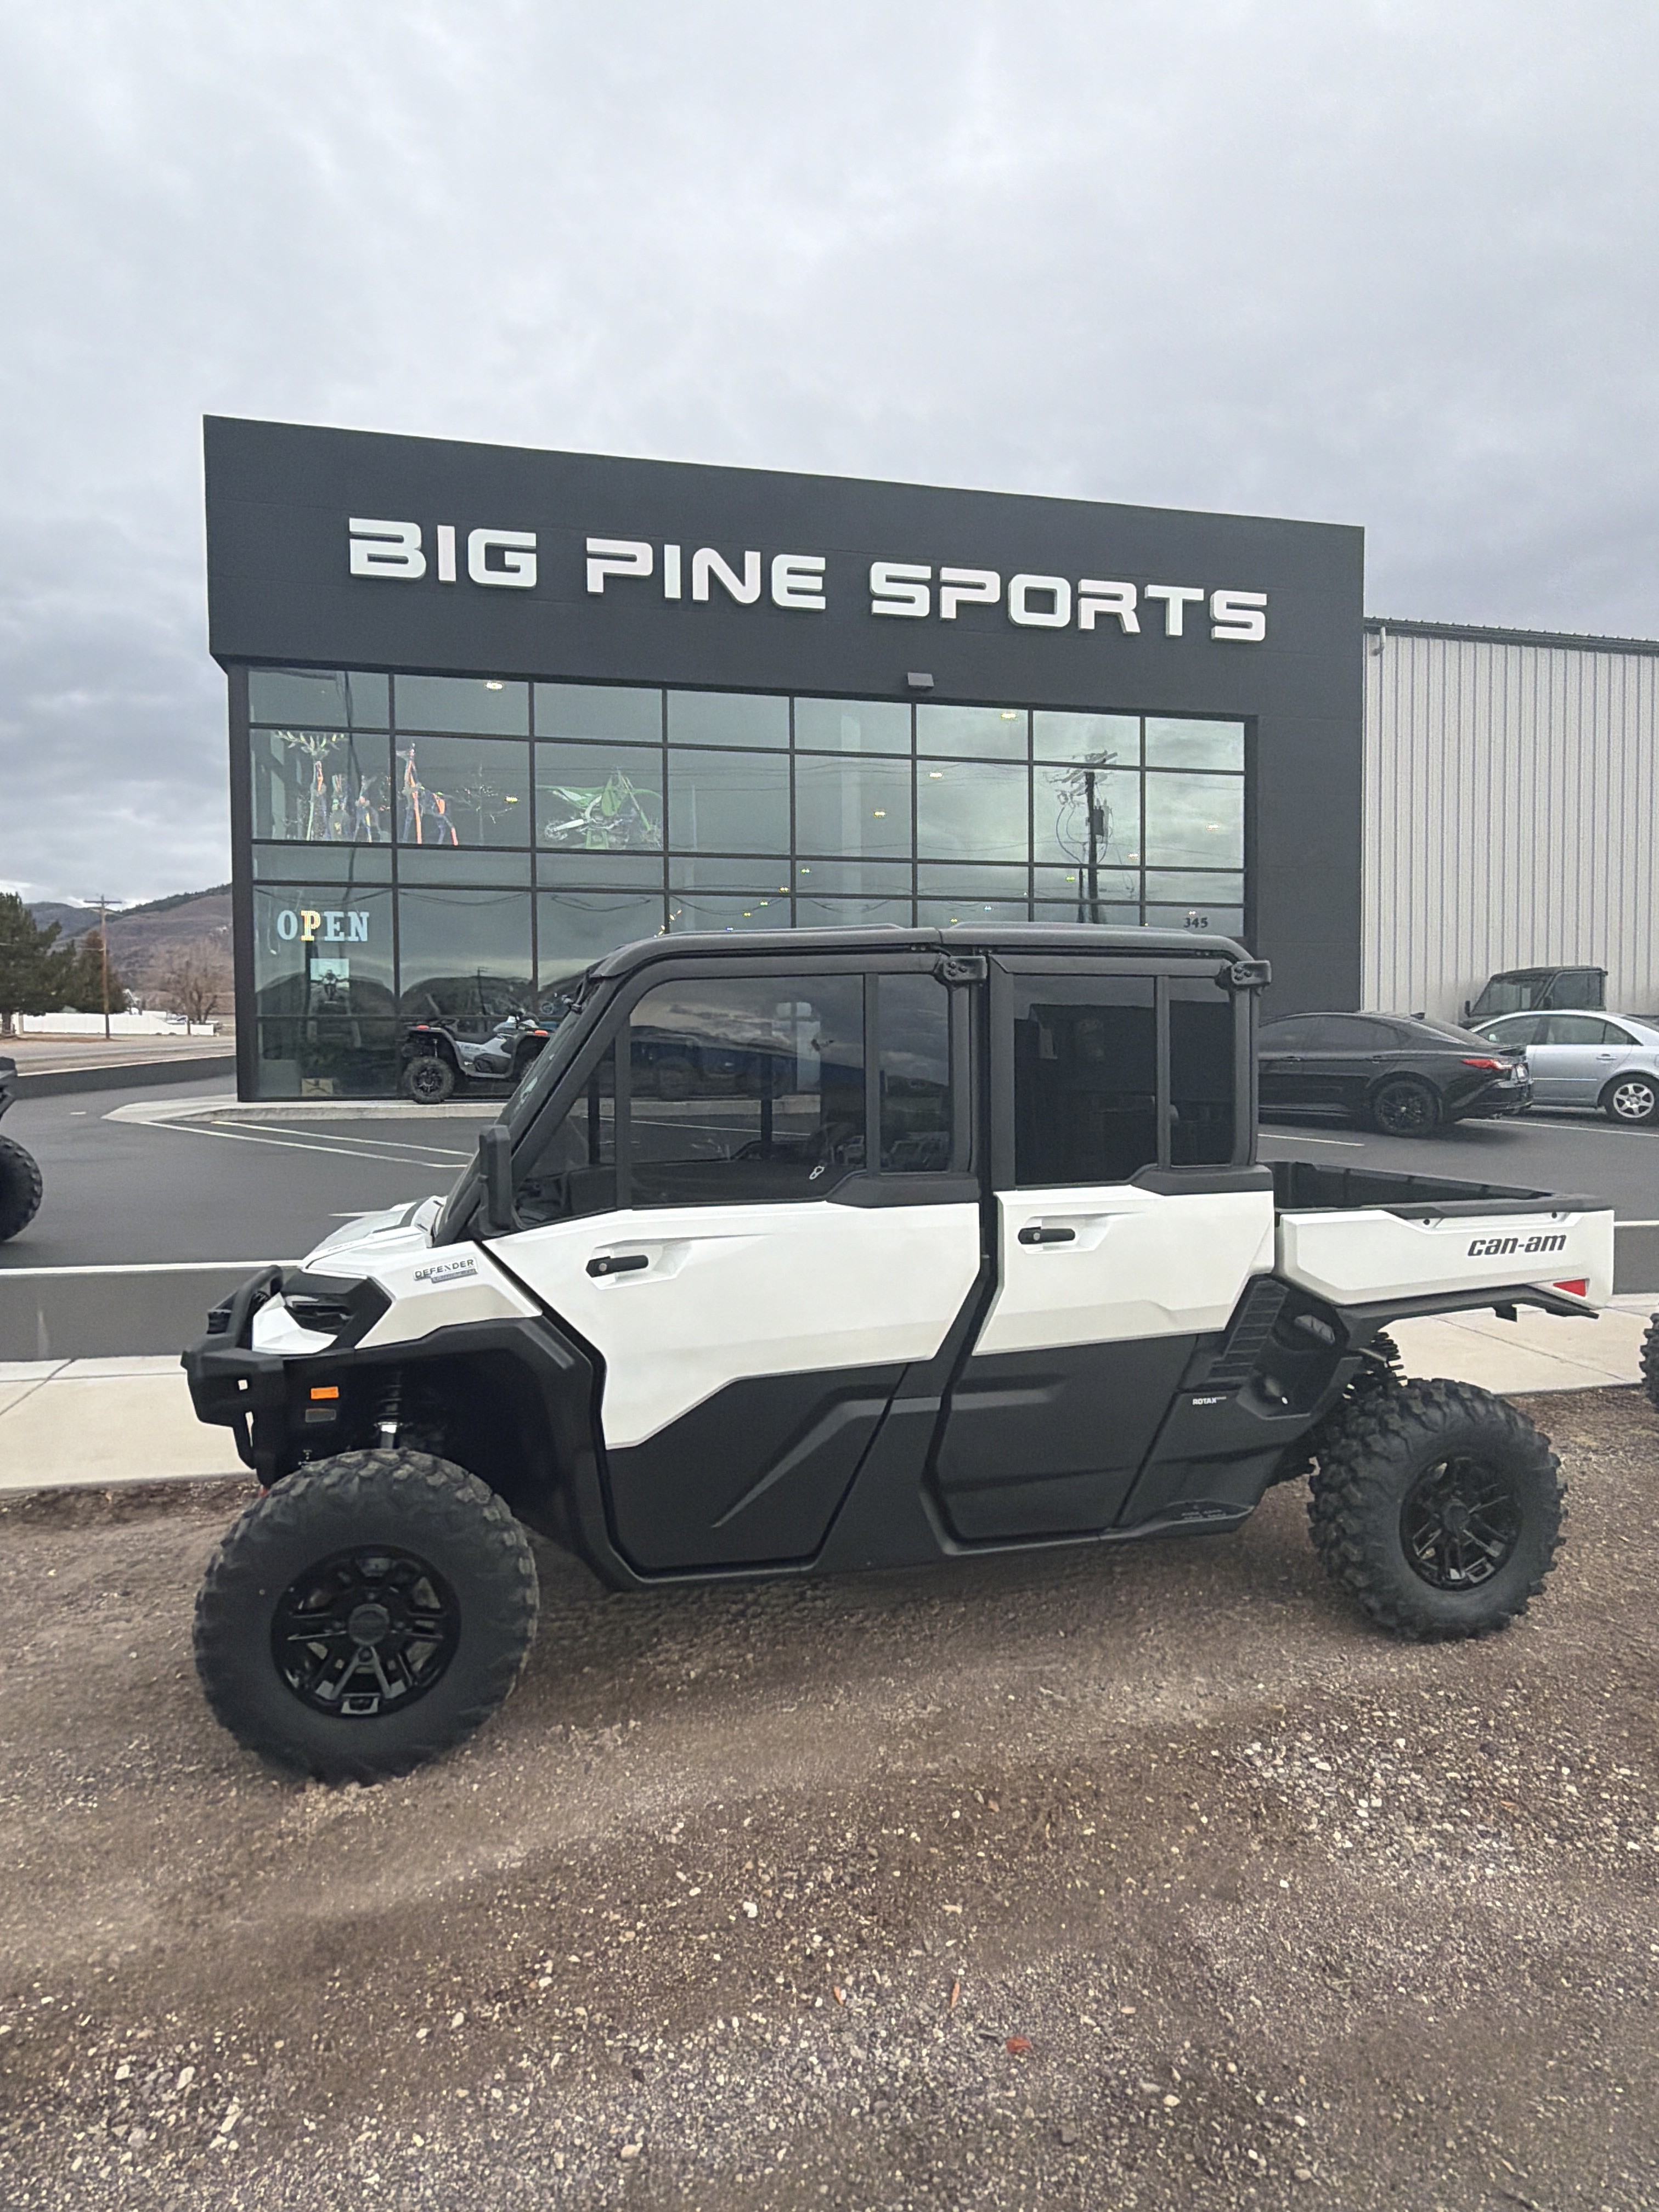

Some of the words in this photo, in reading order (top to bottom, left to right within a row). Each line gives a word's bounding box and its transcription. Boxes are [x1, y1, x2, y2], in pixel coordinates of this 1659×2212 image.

[349, 517, 537, 590] BIG
[586, 537, 827, 611] PINE
[870, 561, 1267, 642] SPORTS
[277, 910, 370, 941] OPEN
[1183, 917, 1208, 928] 345
[1468, 1234, 1566, 1256] can-am
[415, 1259, 474, 1278] DEFENDER
